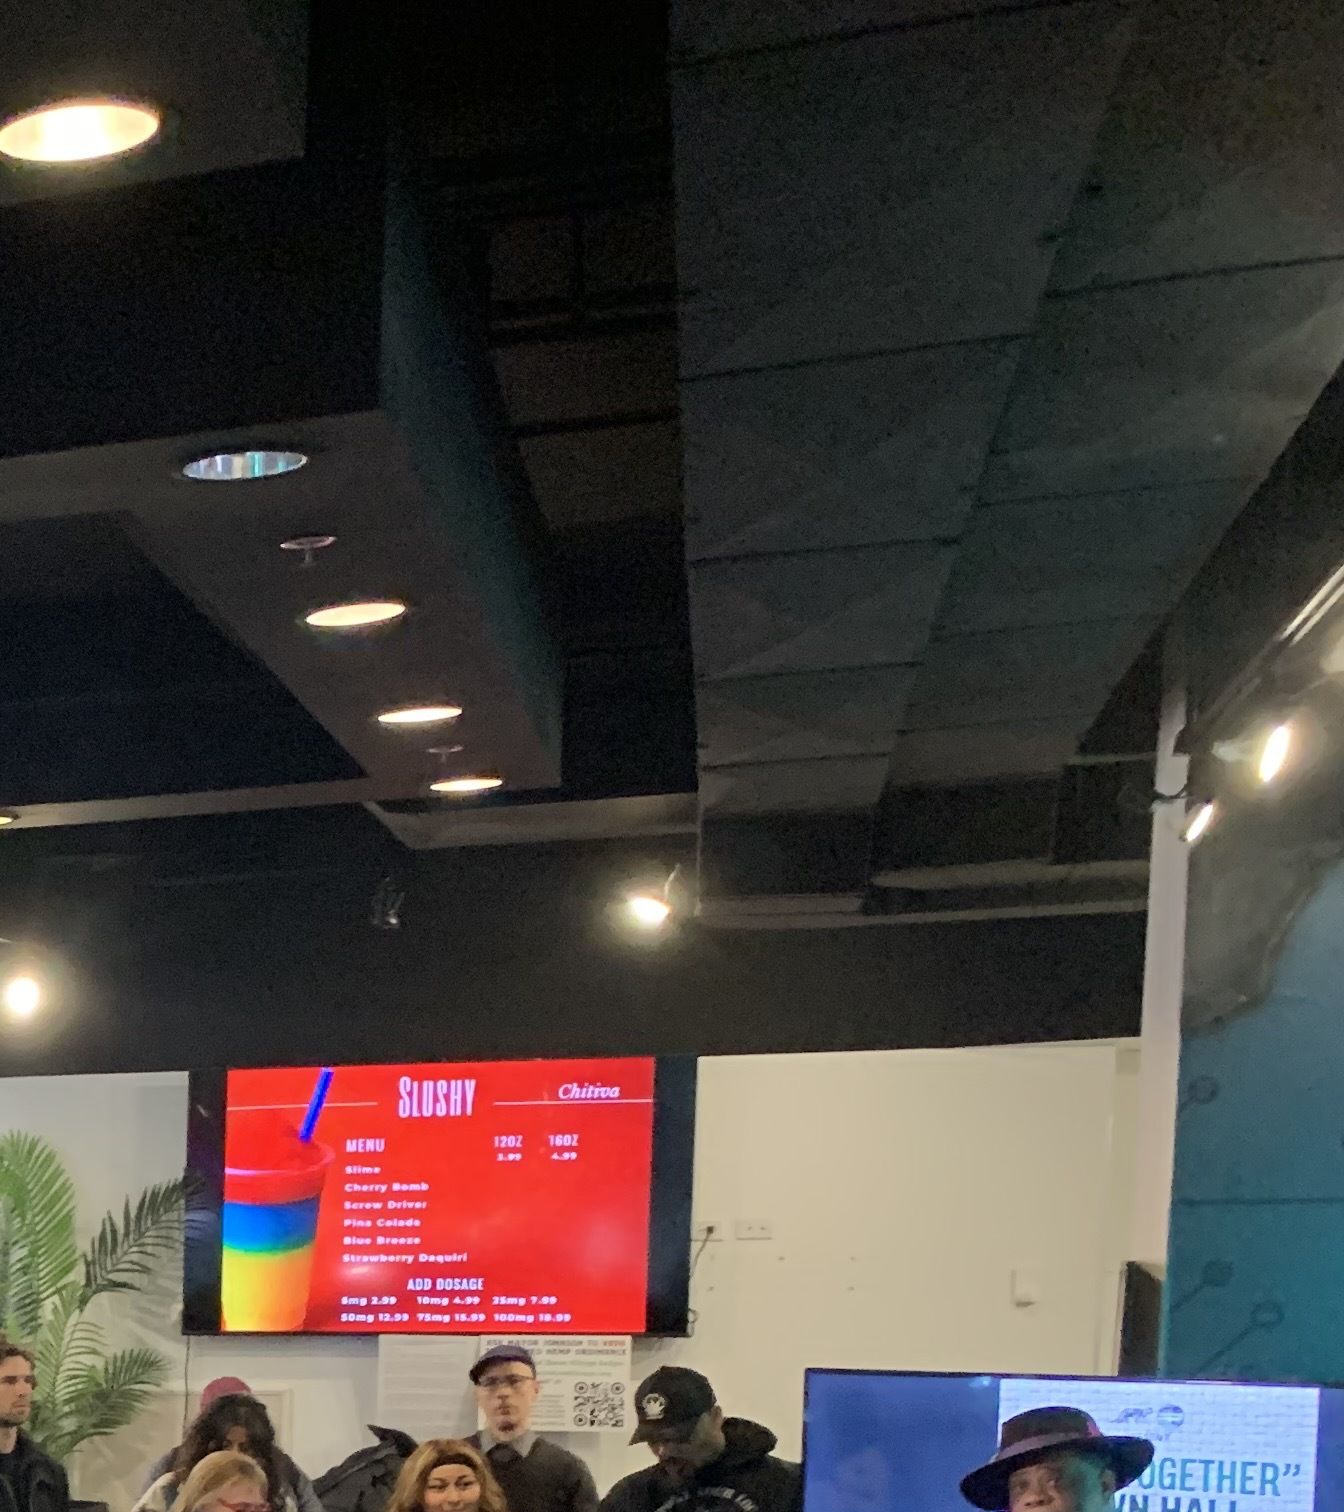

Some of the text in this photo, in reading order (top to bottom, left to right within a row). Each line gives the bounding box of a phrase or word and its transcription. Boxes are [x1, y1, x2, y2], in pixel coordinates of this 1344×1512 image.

[558, 1081, 621, 1100] Chitiva
[346, 1138, 386, 1152] MENU
[551, 1151, 578, 1161] 4.99
[345, 1165, 381, 1175] Slime
[344, 1182, 429, 1194] Cherry Bomb
[344, 1200, 427, 1210] Screw Driver
[343, 1236, 421, 1245] Blue Breeze
[342, 1253, 414, 1264] Strawberry
[407, 1278, 484, 1290] ADD DOSAGE
[371, 1296, 397, 1305] 2.99
[417, 1296, 449, 1306] 10mg
[453, 1296, 480, 1305] 4.99
[530, 1295, 558, 1305] 7.99
[341, 1313, 375, 1323] 50mg
[378, 1313, 409, 1322] 12.99
[417, 1313, 450, 1323] 75mg
[493, 1313, 534, 1323] 100mg
